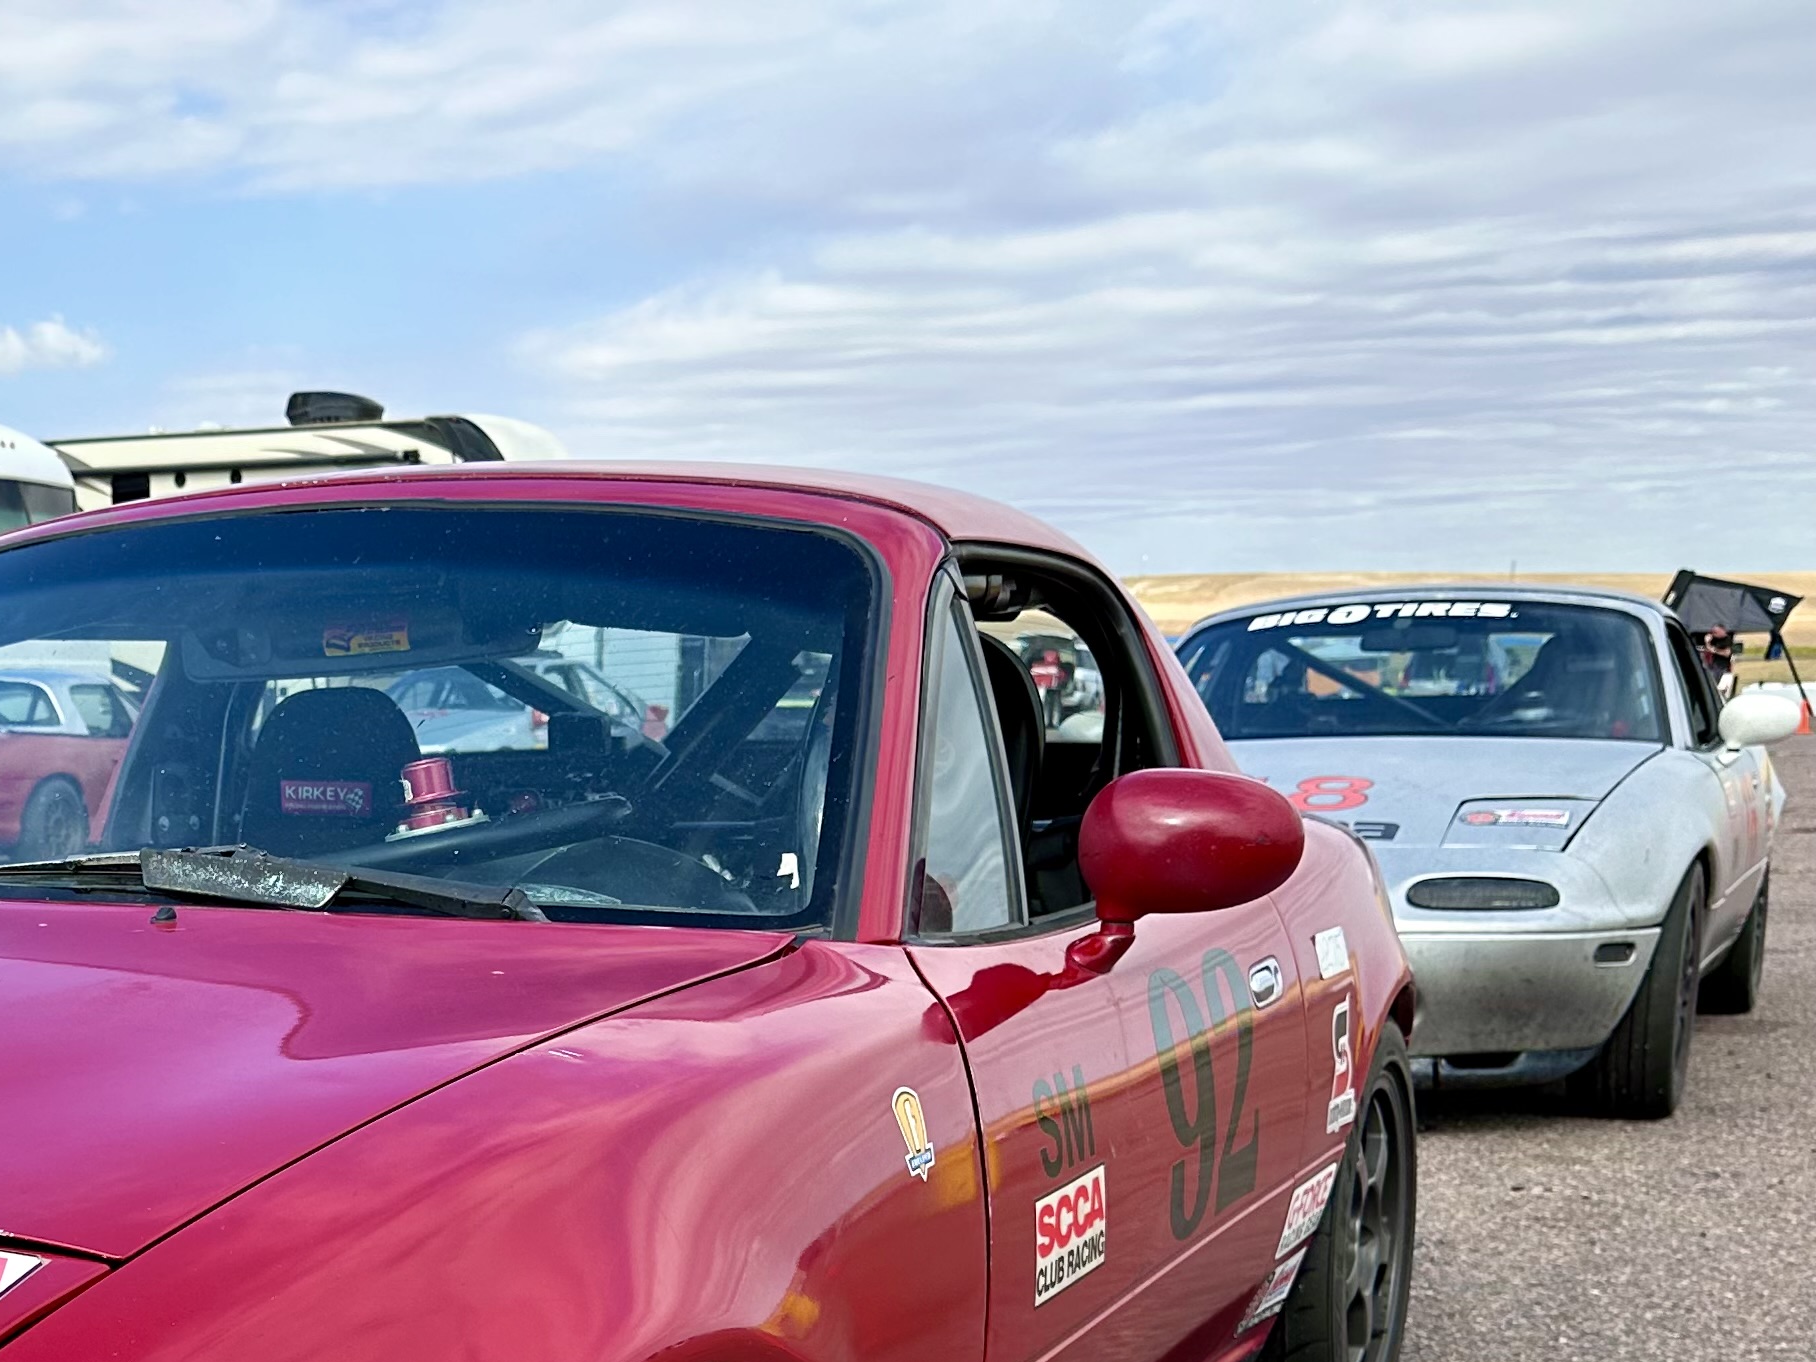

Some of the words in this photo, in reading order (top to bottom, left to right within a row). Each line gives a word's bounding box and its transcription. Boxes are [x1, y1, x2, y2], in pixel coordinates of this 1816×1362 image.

[1247, 608, 1329, 631] BIG
[1327, 604, 1371, 625] O
[1373, 602, 1512, 618] TIRES
[285, 785, 347, 800] KIRKEY
[1032, 1063, 1096, 1179] SM
[1148, 947, 1259, 1242] 92
[1037, 1176, 1104, 1259] SCCA
[1036, 1254, 1065, 1297] CLUB
[1066, 1229, 1105, 1278] RACING
